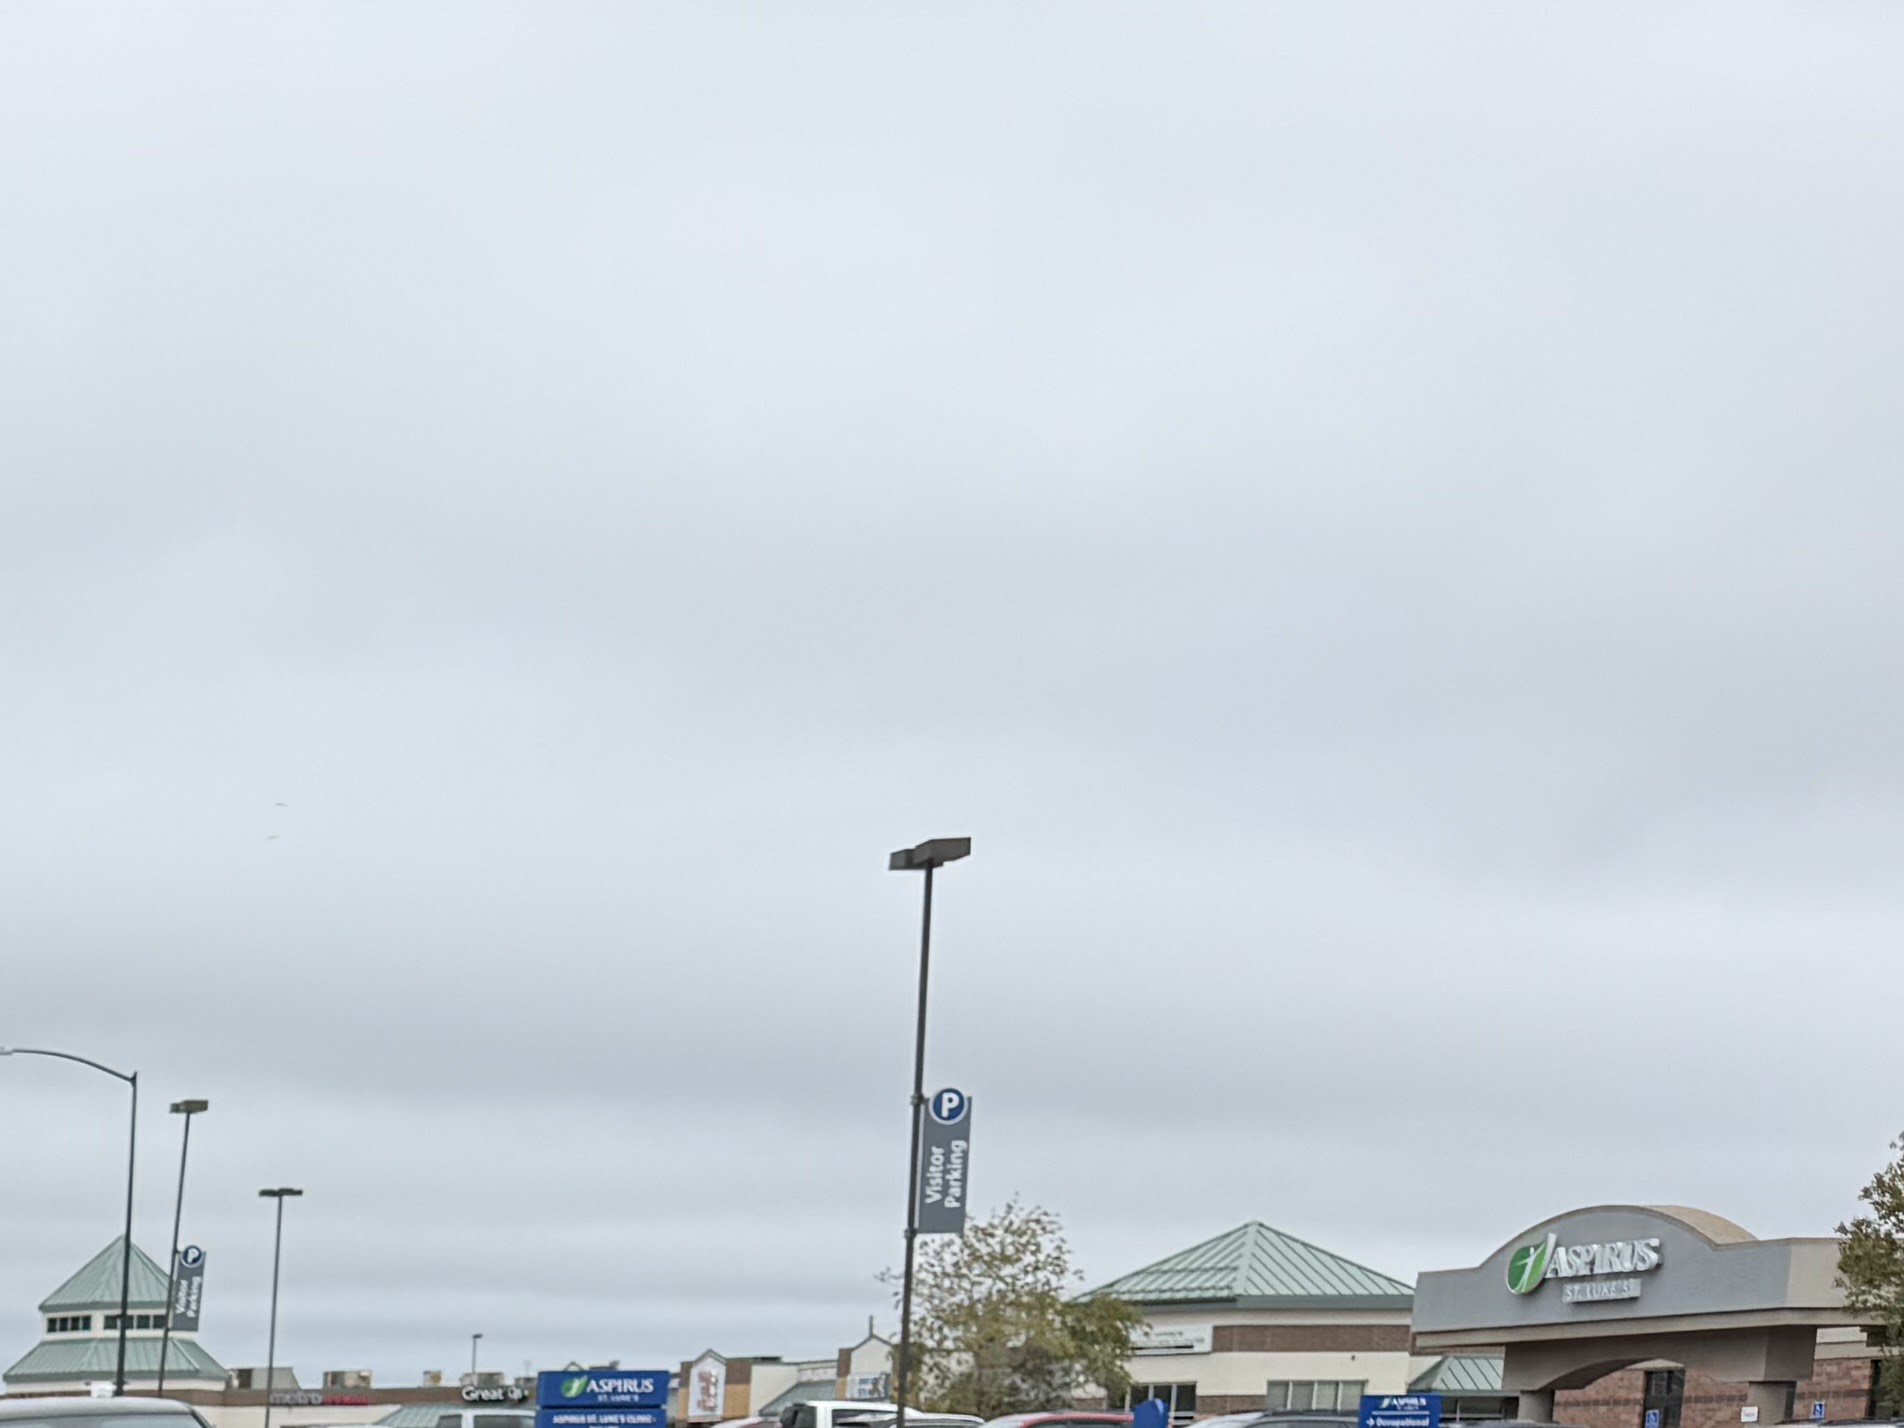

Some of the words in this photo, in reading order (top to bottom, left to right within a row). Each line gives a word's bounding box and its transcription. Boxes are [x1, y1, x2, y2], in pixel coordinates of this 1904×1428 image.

[941, 1092, 959, 1118] P
[925, 1146, 945, 1203] Visitor
[944, 1140, 967, 1208] Parking
[1545, 1238, 1660, 1278] ASPIRUS
[462, 1385, 505, 1401] Great
[586, 1378, 654, 1393] ASPIRUS
